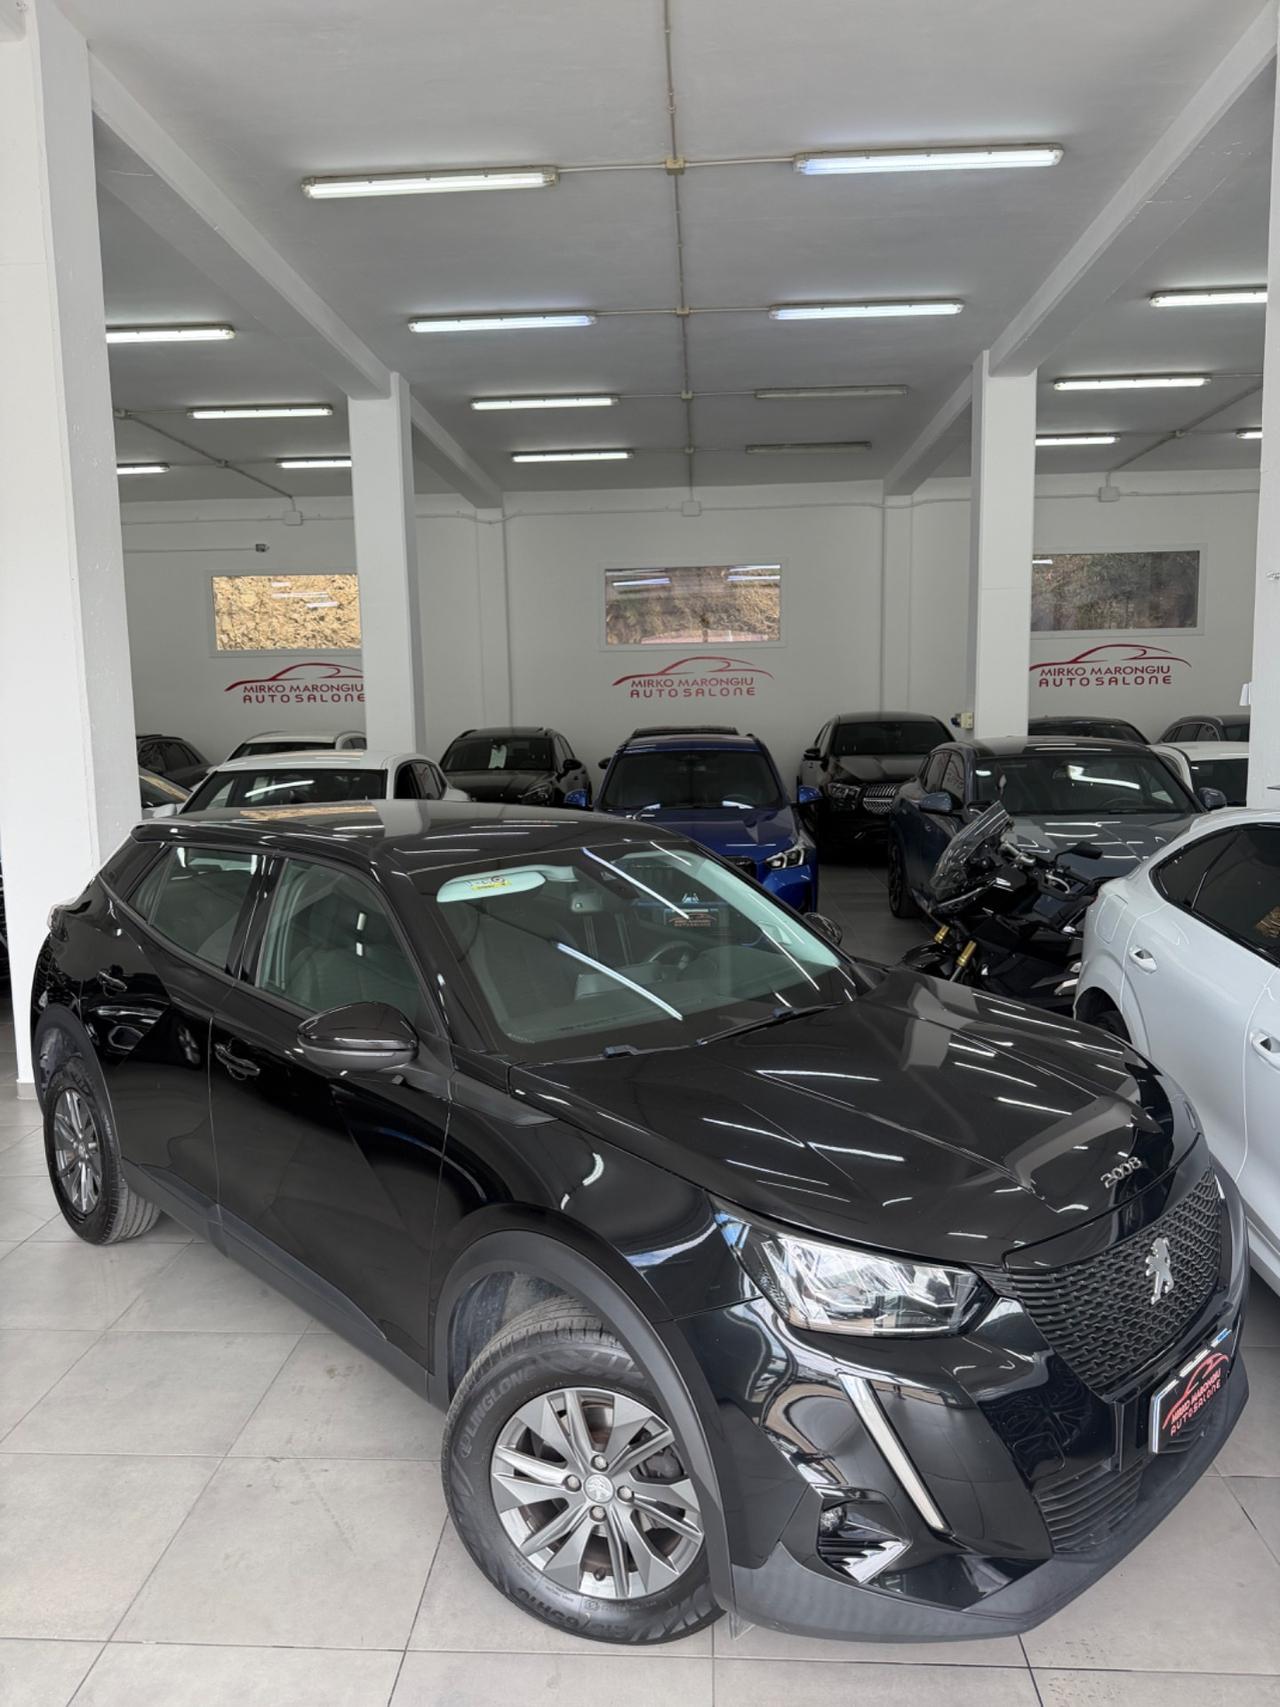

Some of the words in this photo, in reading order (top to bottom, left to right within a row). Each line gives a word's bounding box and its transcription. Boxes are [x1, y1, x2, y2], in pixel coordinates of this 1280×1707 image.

[1040, 667, 1086, 677] MIRKO
[1090, 665, 1171, 675] MARONGIU
[631, 678, 674, 688] MIRKO
[677, 677, 754, 687] MARONGIU
[1038, 675, 1172, 687] AUTOSALONE
[243, 684, 286, 693] MIRKO
[289, 683, 364, 693] MARONGIU
[630, 687, 756, 698] AUTOSALONE
[242, 693, 366, 704] AUTOSALONE
[1100, 1156, 1142, 1188] 2008
